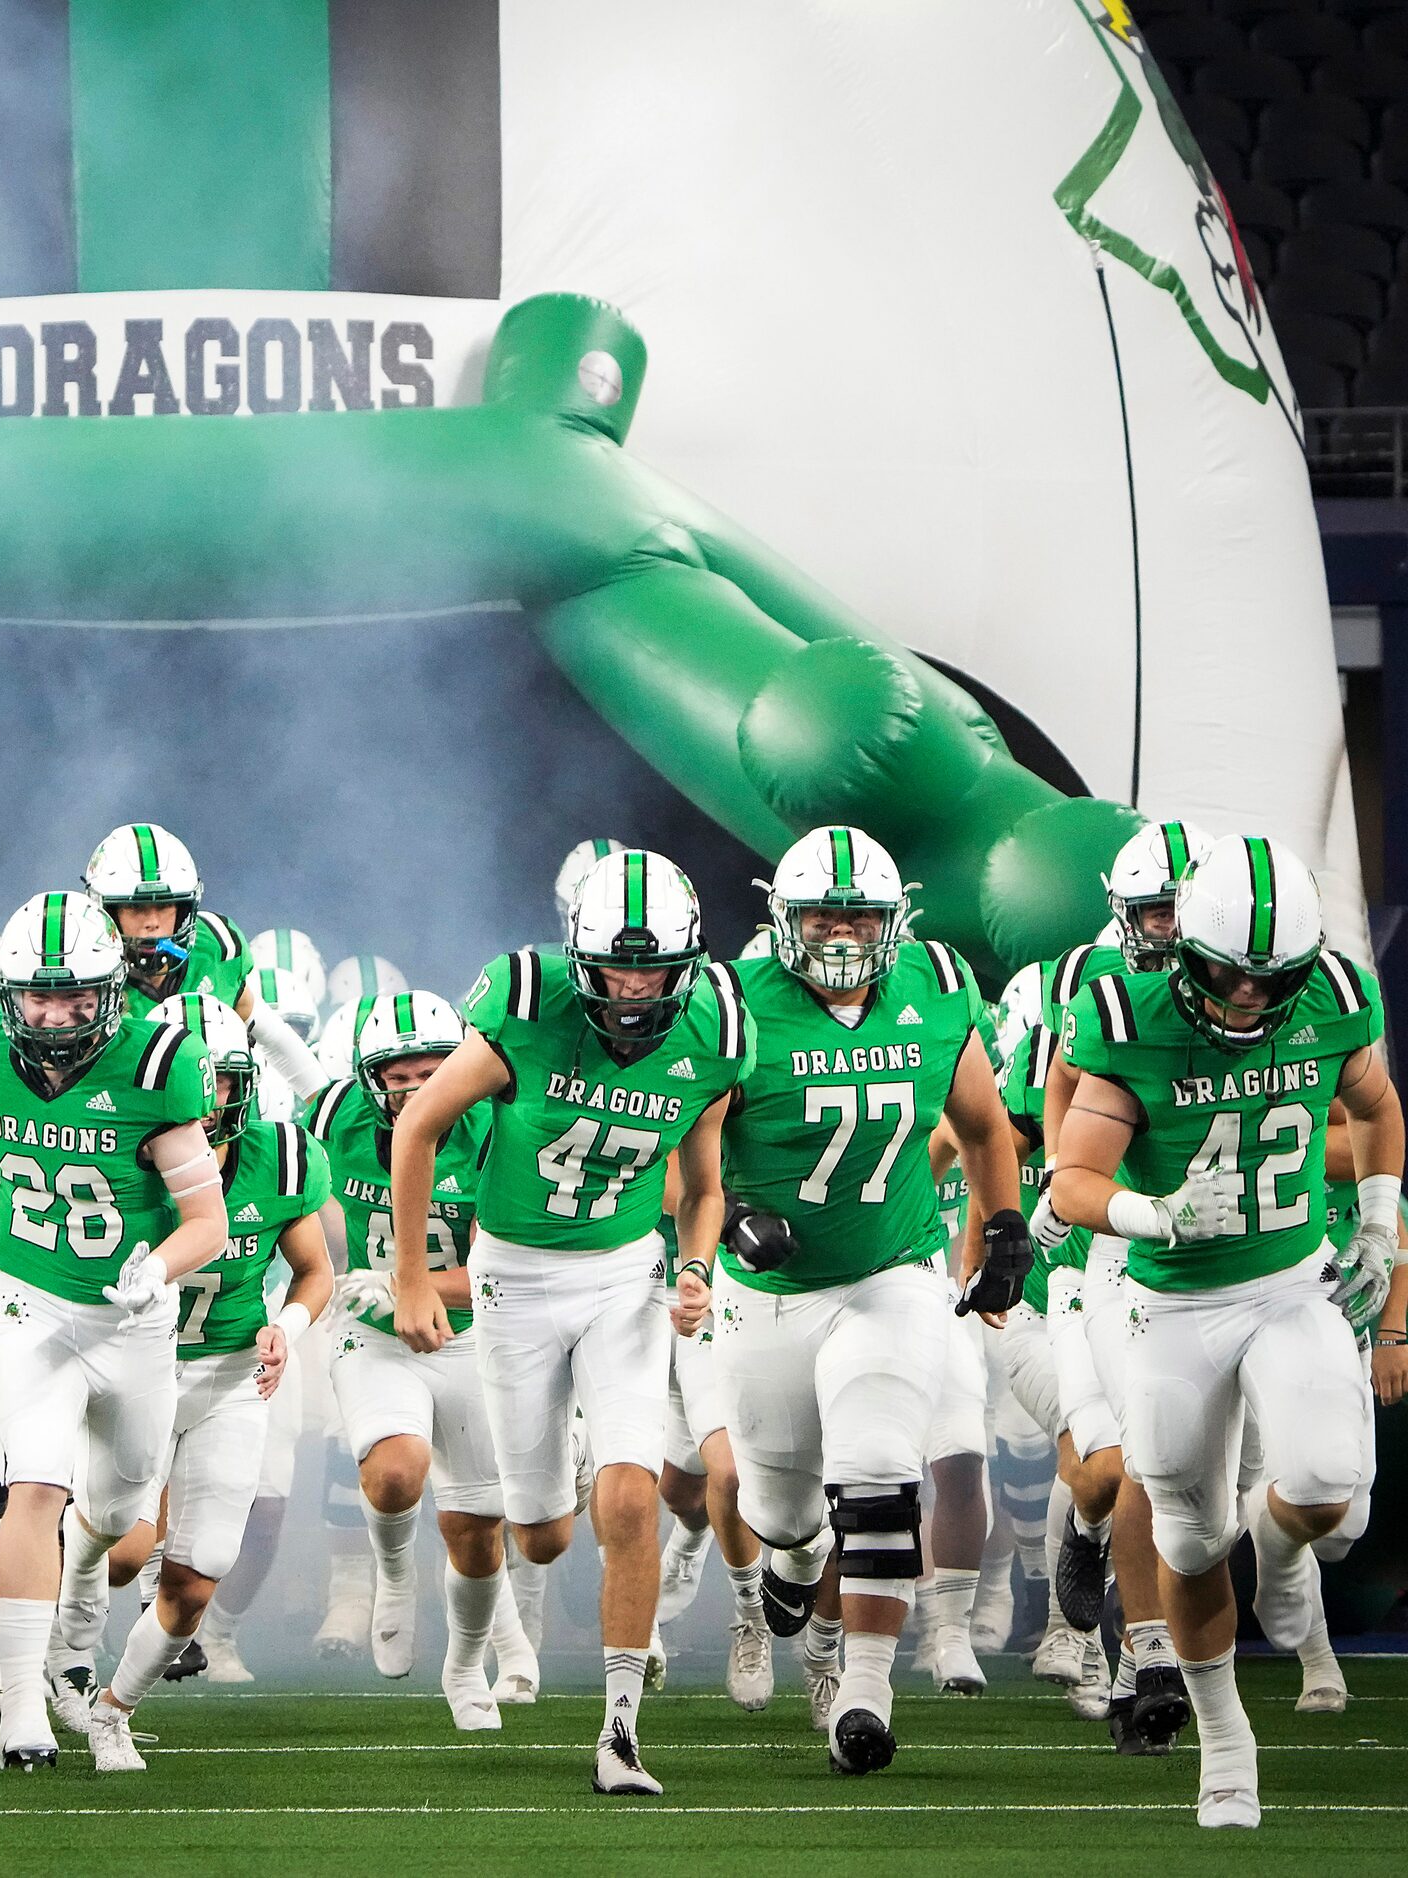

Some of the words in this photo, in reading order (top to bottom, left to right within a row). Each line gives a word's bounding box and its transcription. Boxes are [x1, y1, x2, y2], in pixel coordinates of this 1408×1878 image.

[896, 1016, 923, 1025] adidas
[667, 1066, 697, 1081] adidas
[791, 1043, 922, 1076] DRAGONS
[545, 1072, 683, 1123] DRAGONS
[1171, 1058, 1320, 1108] DRAGONS
[86, 1100, 117, 1112] adidas
[798, 1081, 916, 1204] 77
[536, 1115, 661, 1220] 47
[1185, 1102, 1314, 1236] 42
[233, 1213, 264, 1223] adidas
